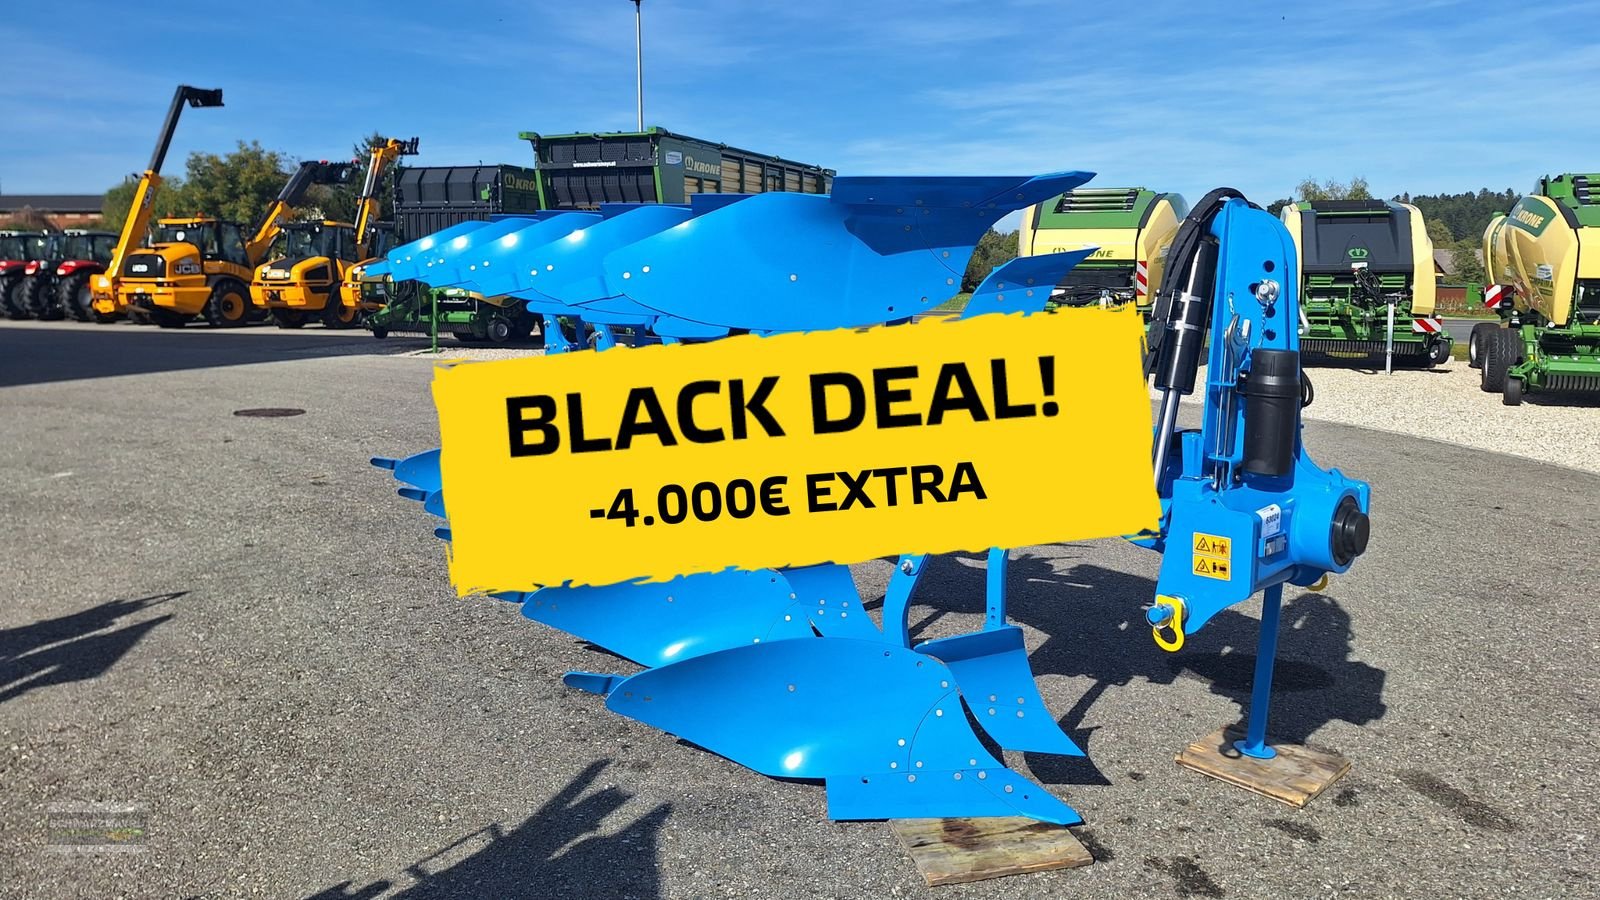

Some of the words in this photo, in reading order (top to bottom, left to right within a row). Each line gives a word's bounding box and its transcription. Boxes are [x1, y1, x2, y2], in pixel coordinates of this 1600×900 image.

[694, 161, 721, 175] KRONE
[515, 178, 536, 191] KRO
[1516, 209, 1544, 229] KRONE
[174, 263, 201, 275] JCB
